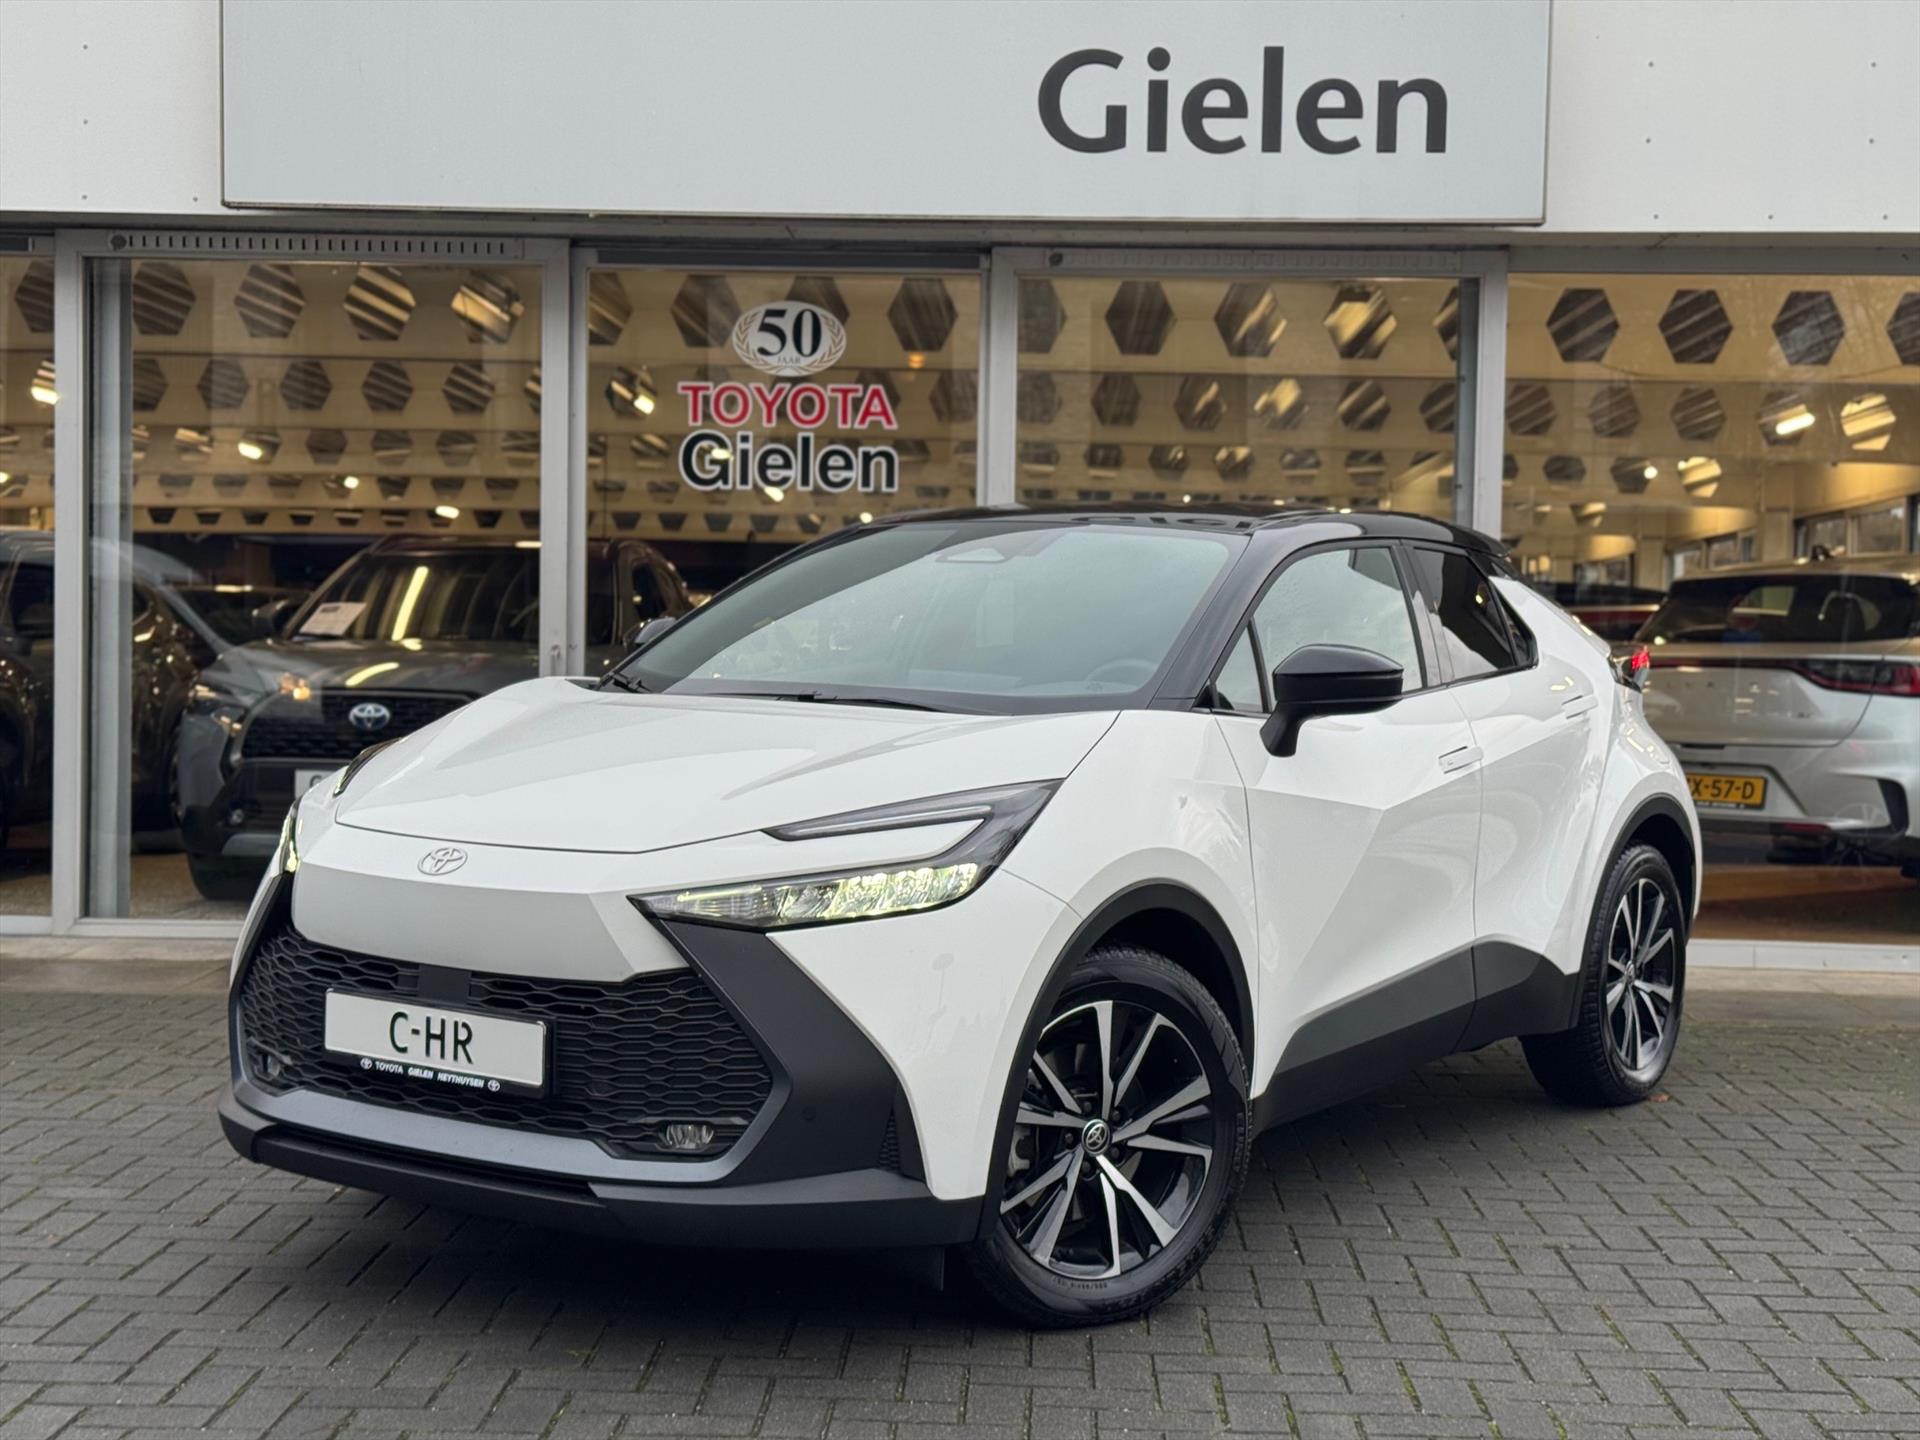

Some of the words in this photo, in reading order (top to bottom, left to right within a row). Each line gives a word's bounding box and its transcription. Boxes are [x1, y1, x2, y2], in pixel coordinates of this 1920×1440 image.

[1038, 46, 1447, 155] Gielen
[757, 308, 822, 357] 50
[678, 382, 897, 429] TOYOTA
[679, 430, 899, 492] Gielen
[1685, 777, 1755, 800] X-57-D
[389, 1011, 474, 1065] C-HR
[375, 1062, 404, 1074] TOYOTA
[408, 1067, 434, 1079] GIELEN
[437, 1072, 485, 1088] HEYTHUYSEN
